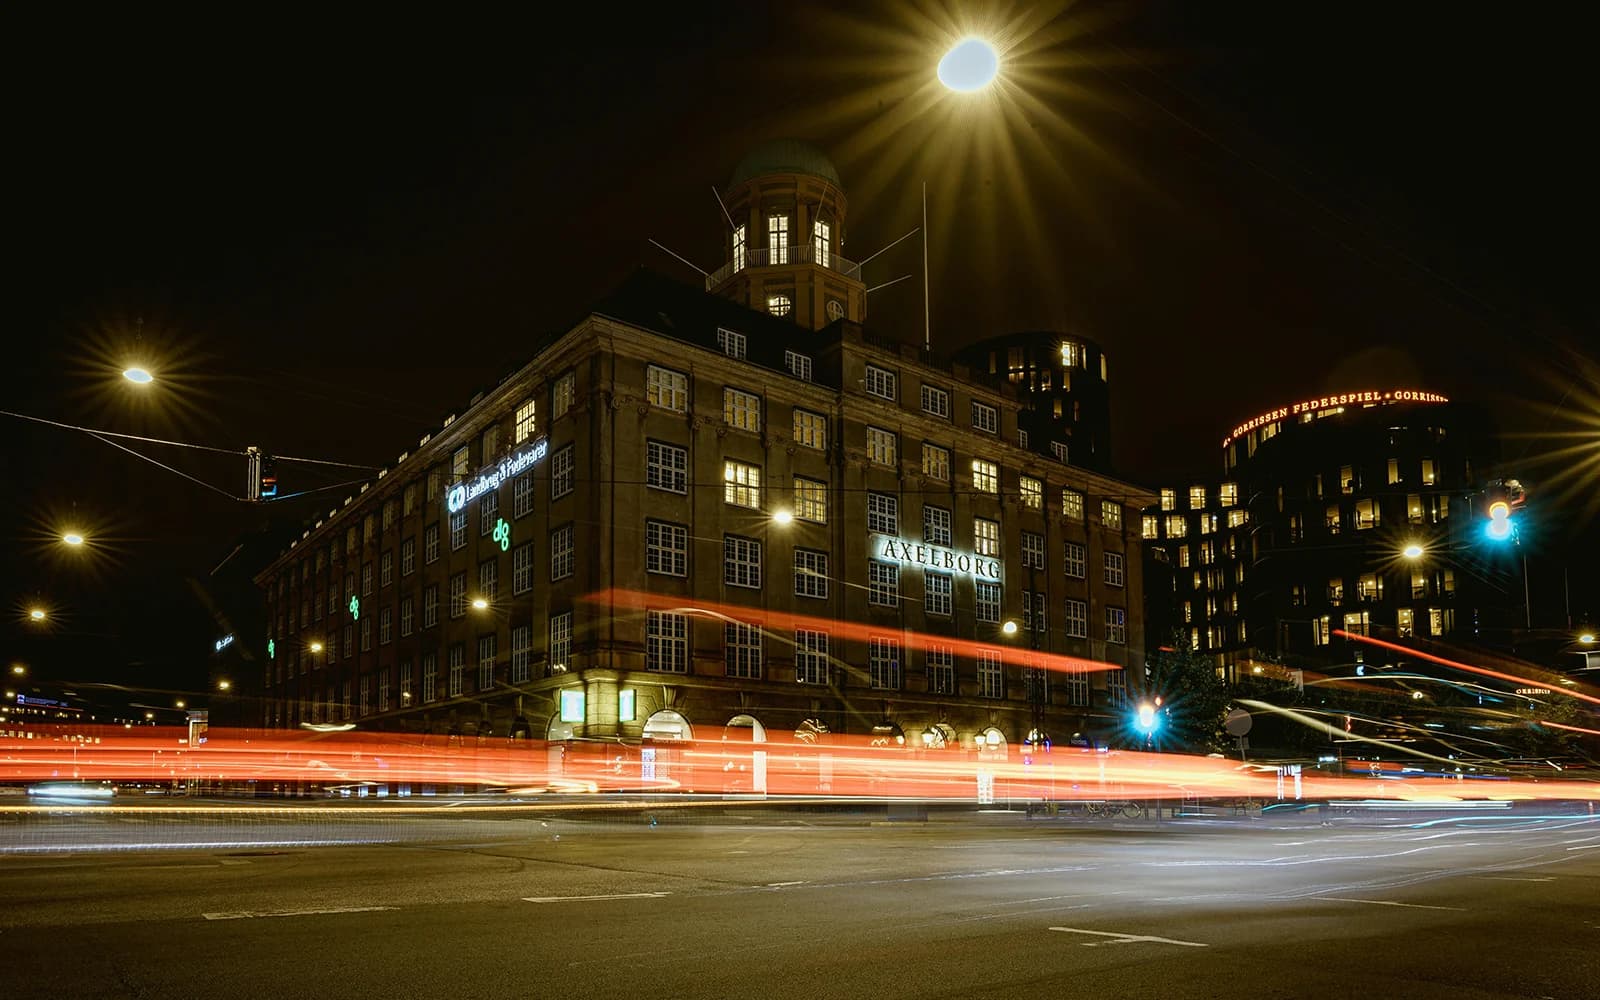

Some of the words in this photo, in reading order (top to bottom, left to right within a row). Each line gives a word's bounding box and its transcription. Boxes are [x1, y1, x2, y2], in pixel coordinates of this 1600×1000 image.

[1233, 407, 1288, 438] GORRISSEN
[1293, 391, 1382, 414] FEDERSPIEL
[1394, 390, 1449, 402] GORRISS
[499, 463, 506, 481] &
[883, 538, 1001, 578] AXELBORG
